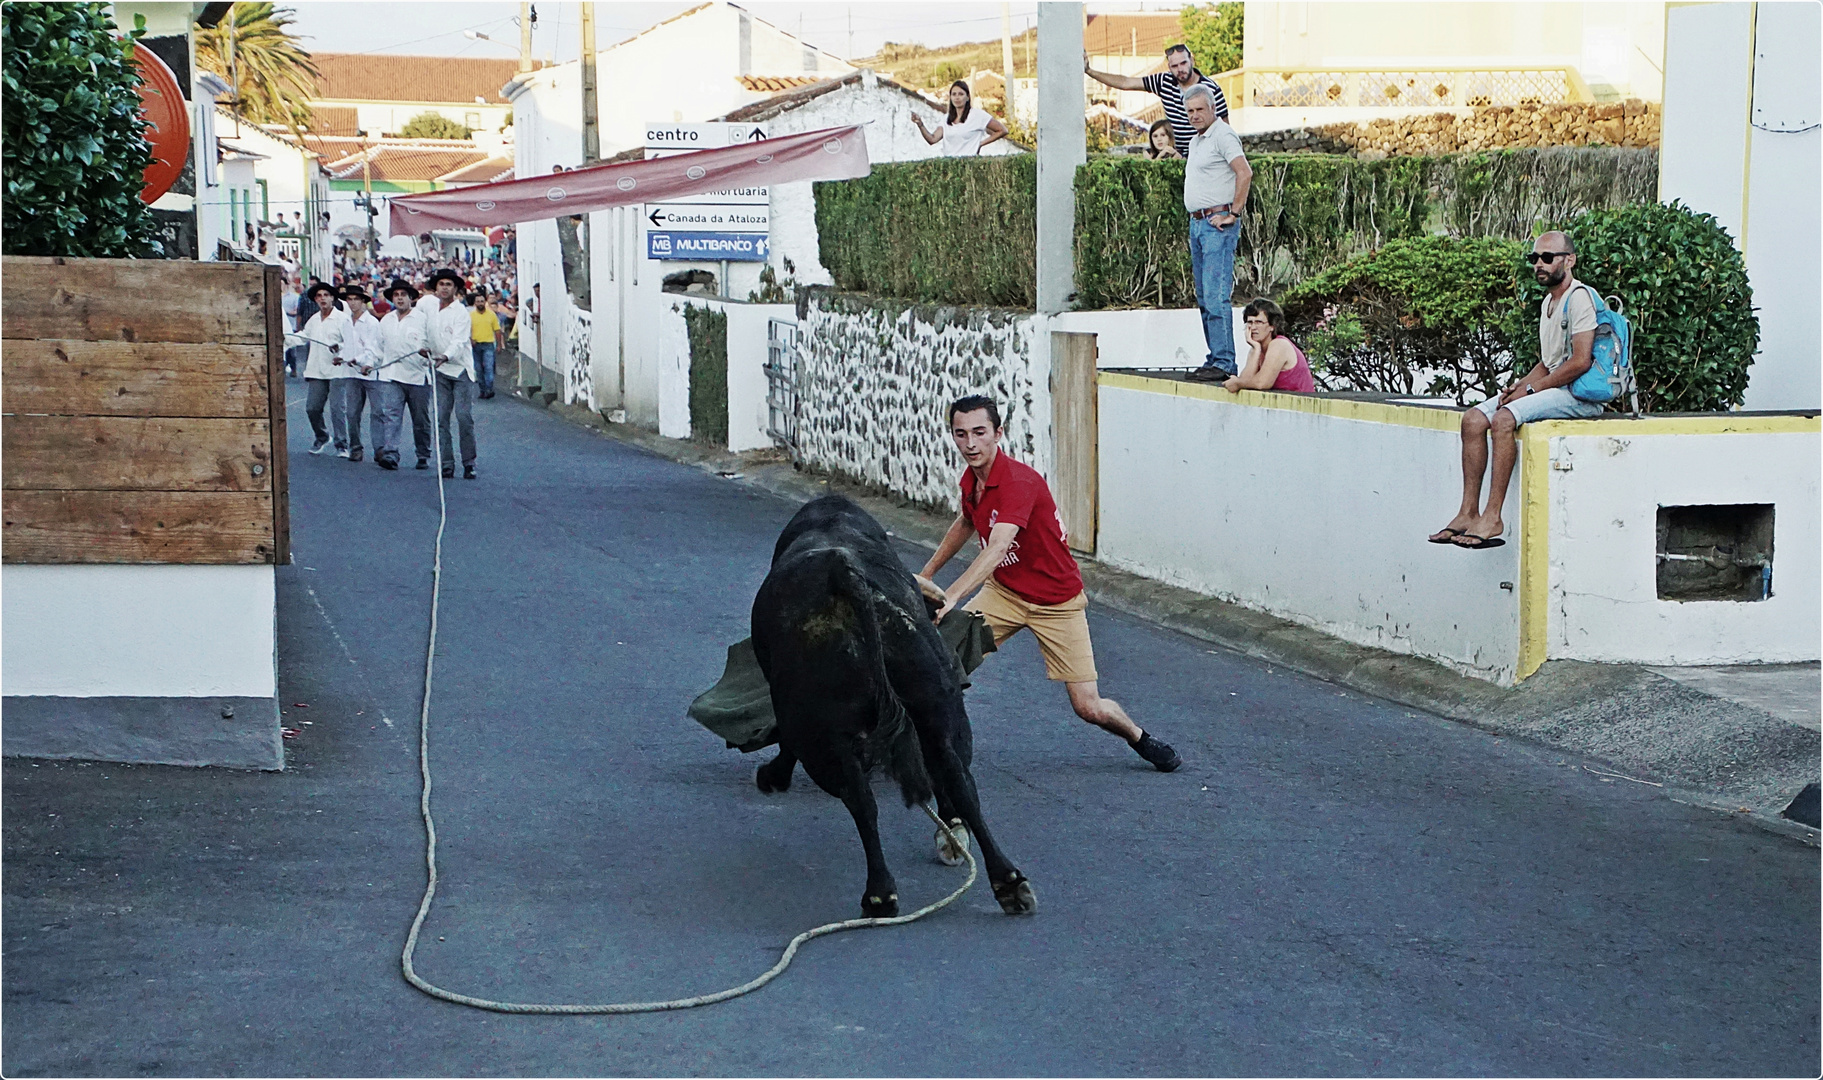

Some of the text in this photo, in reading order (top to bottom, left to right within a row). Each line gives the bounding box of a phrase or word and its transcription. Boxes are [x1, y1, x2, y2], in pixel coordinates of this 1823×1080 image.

[647, 128, 698, 140] centro
[667, 213, 767, 224] Canada da Ataloza
[652, 239, 752, 251] MB MULTIBANCO
